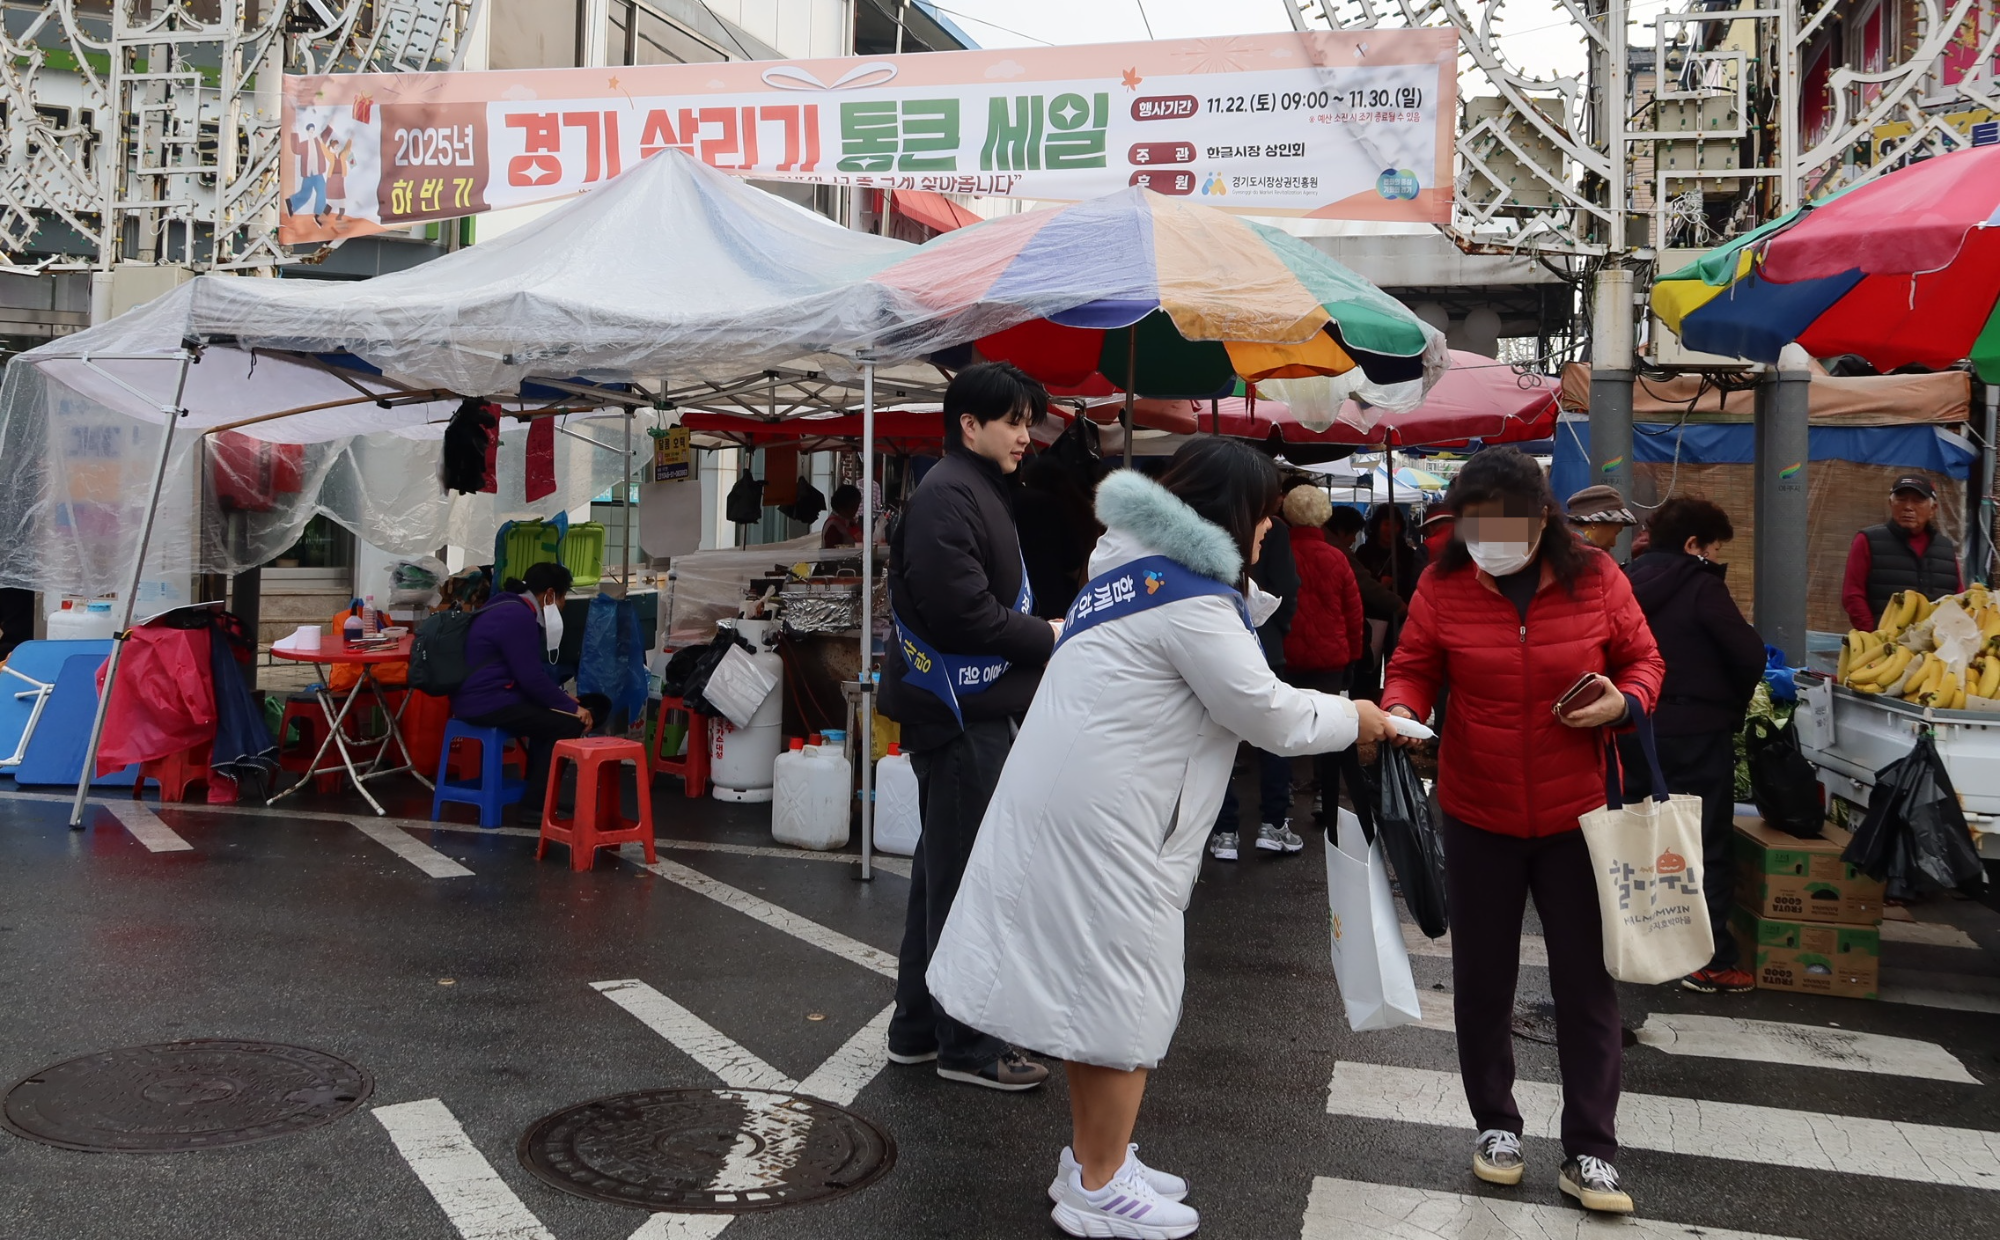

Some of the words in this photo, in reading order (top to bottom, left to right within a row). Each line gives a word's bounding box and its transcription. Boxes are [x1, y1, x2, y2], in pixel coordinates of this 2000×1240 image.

[1138, 99, 1193, 118] 행사기간
[1206, 92, 1277, 114] 11.22.(토)
[1280, 90, 1329, 111] 09:00
[1348, 86, 1423, 109] 11.30.(일)
[1317, 114, 1333, 124] 예산
[1334, 113, 1349, 123] 소진
[1358, 112, 1373, 122] 조기
[1406, 111, 1421, 123] 있음
[394, 124, 475, 167] 2025년
[504, 111, 622, 188] 경기
[639, 103, 822, 172] 살리기
[836, 97, 961, 172] 통큰
[979, 91, 1110, 172] 세일
[1206, 146, 1261, 159] 한글시장
[1264, 142, 1306, 158] 상인회
[1231, 175, 1319, 189] 경기도시장상권진흥원
[1778, 484, 1801, 492] 여주시
[903, 639, 932, 674] 사랑
[1774, 896, 1802, 906] GOOD
[1772, 904, 1803, 914] FRUTA
[1764, 968, 1793, 977] GOOD
[1762, 975, 1793, 986] FRUTA
